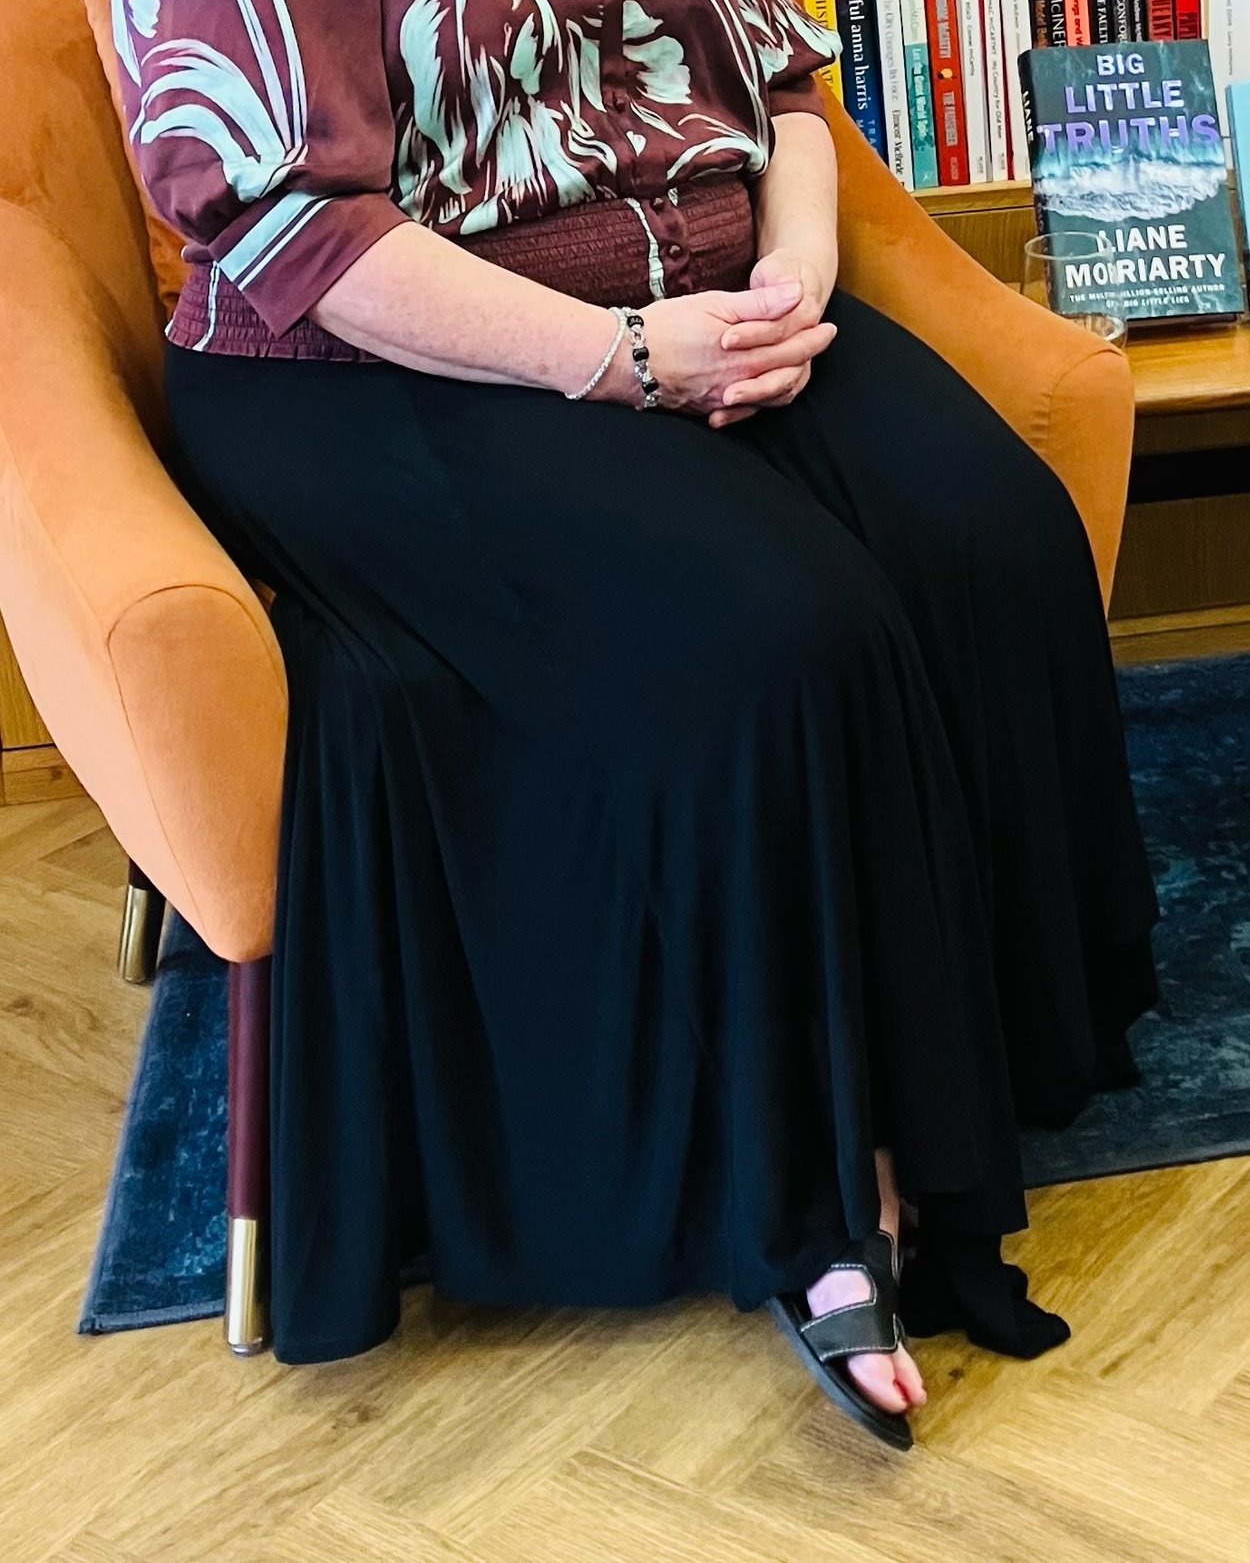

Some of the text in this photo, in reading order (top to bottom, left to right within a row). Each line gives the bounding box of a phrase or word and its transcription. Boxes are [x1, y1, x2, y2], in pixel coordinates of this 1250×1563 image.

[850, 25, 865, 60] anna
[1096, 54, 1145, 76] BIG
[854, 65, 869, 110] harris
[1065, 80, 1184, 113] LITTLE
[1037, 115, 1220, 154] TRUTHS
[1098, 225, 1187, 252] LIANE
[1064, 253, 1226, 289] MORIARTY
